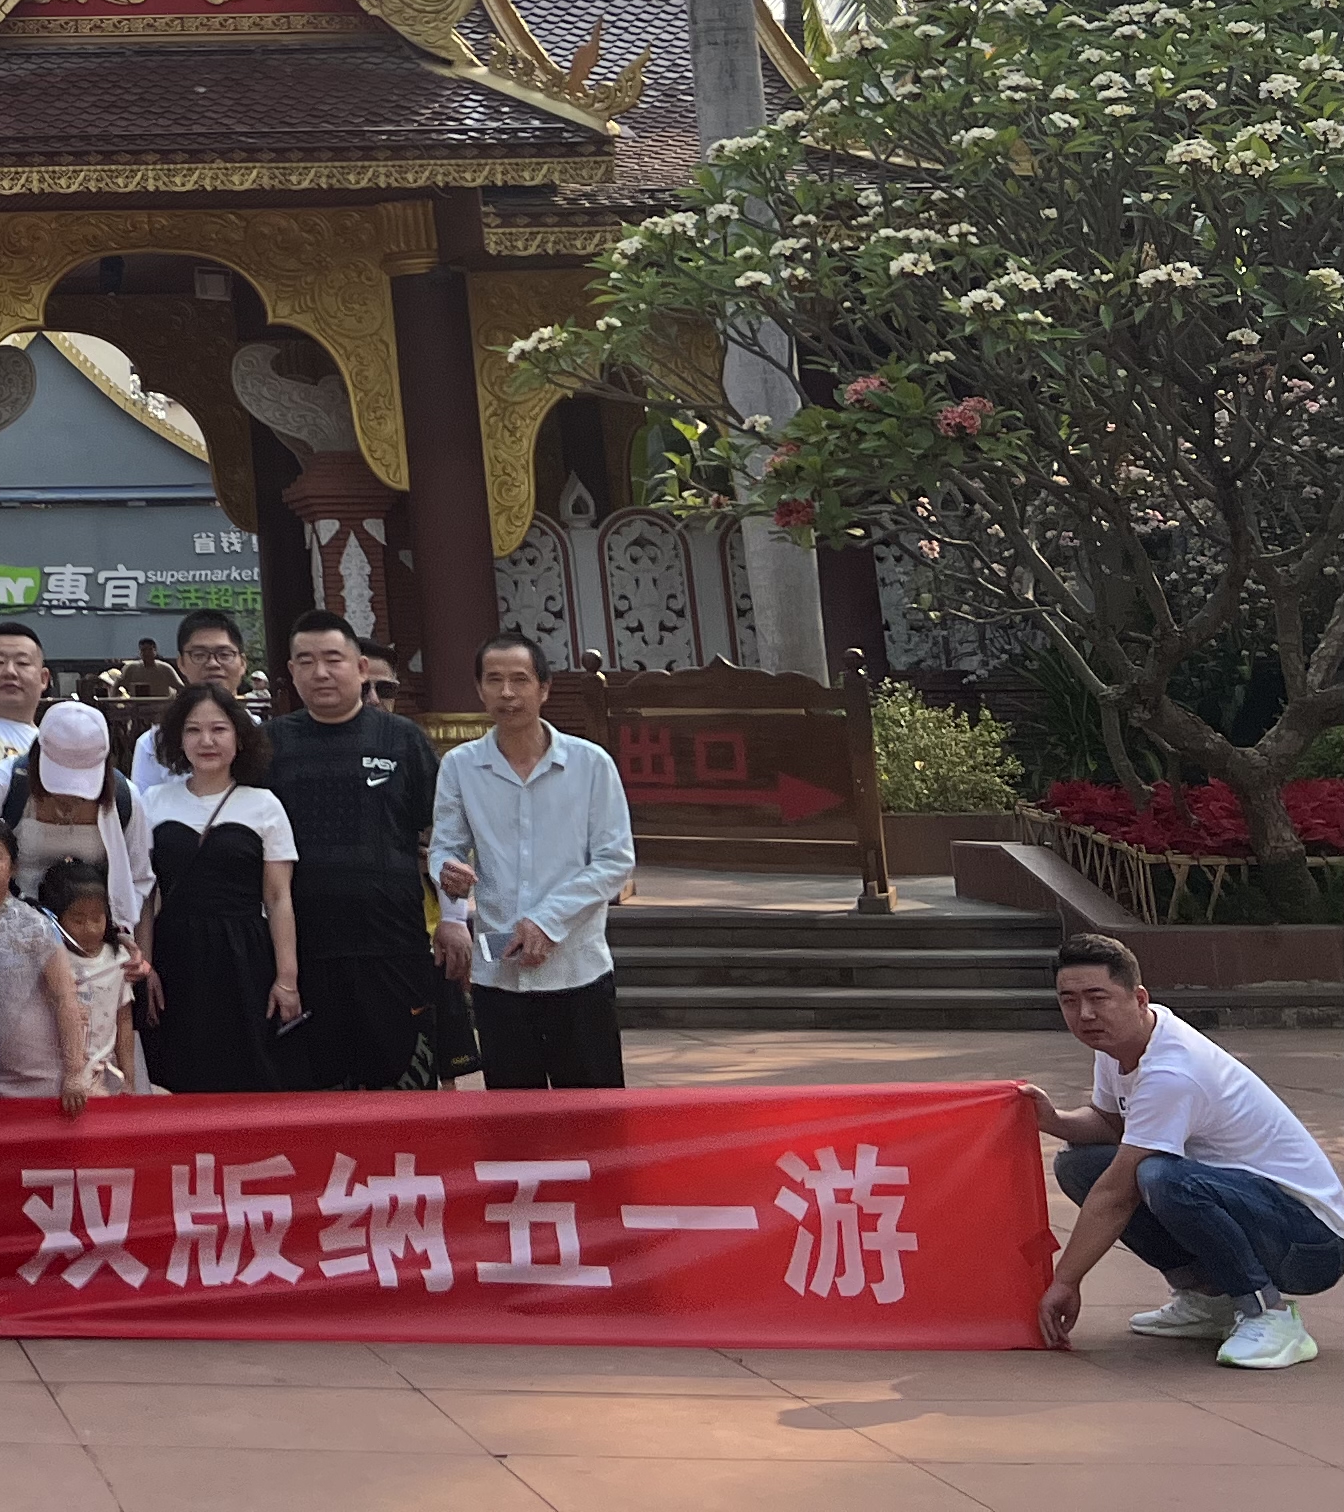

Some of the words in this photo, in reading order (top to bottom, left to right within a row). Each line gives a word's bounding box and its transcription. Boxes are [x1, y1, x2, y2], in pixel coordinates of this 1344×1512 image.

[37, 564, 146, 615] 惠宜
[146, 566, 259, 585] supermarket
[148, 585, 262, 610] 生活超市
[619, 724, 747, 784] 出口
